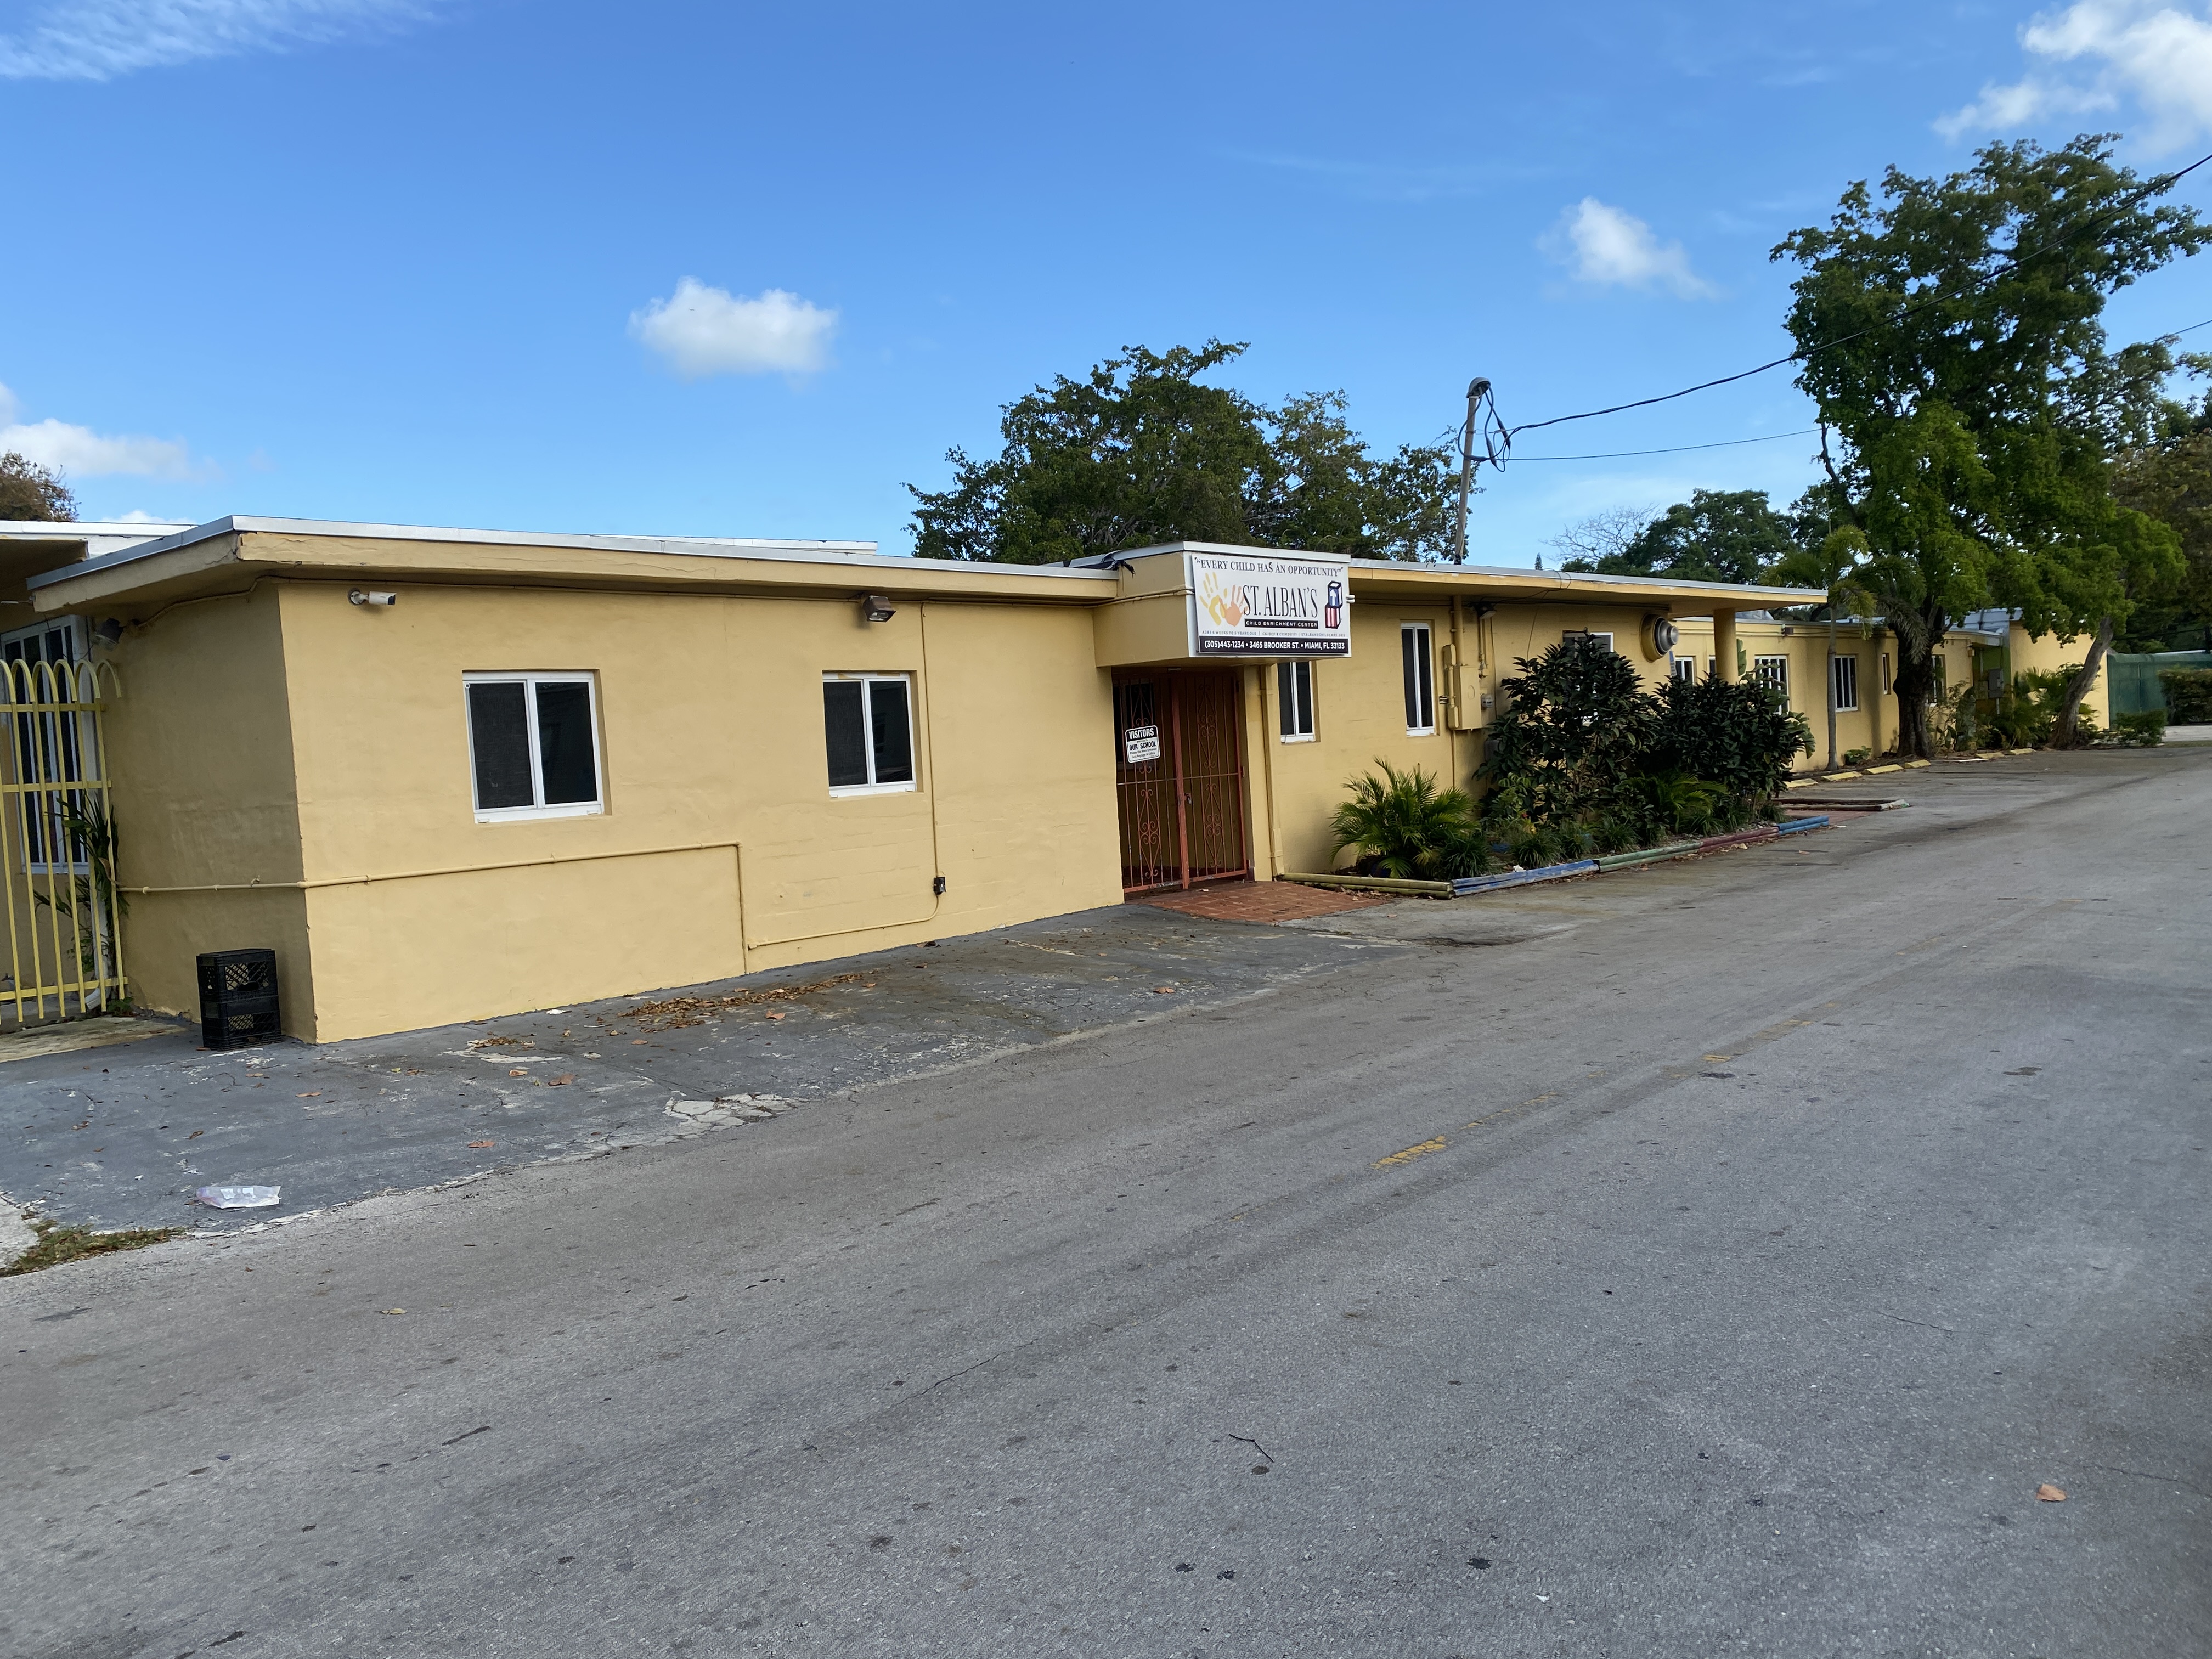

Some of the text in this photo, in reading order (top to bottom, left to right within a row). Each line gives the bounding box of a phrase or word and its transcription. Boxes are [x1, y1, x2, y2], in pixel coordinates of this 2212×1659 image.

[1197, 559, 1341, 577] "EVERY CHILD HAS AN OPPORTUNITY"
[1243, 585, 1318, 618] ST. ALBAN'S
[1204, 640, 1244, 648] (305)443-1234
[1305, 642, 1322, 650] MIAMI,
[1129, 728, 1154, 739] VISITORS
[1140, 741, 1156, 749] SCHOOL
